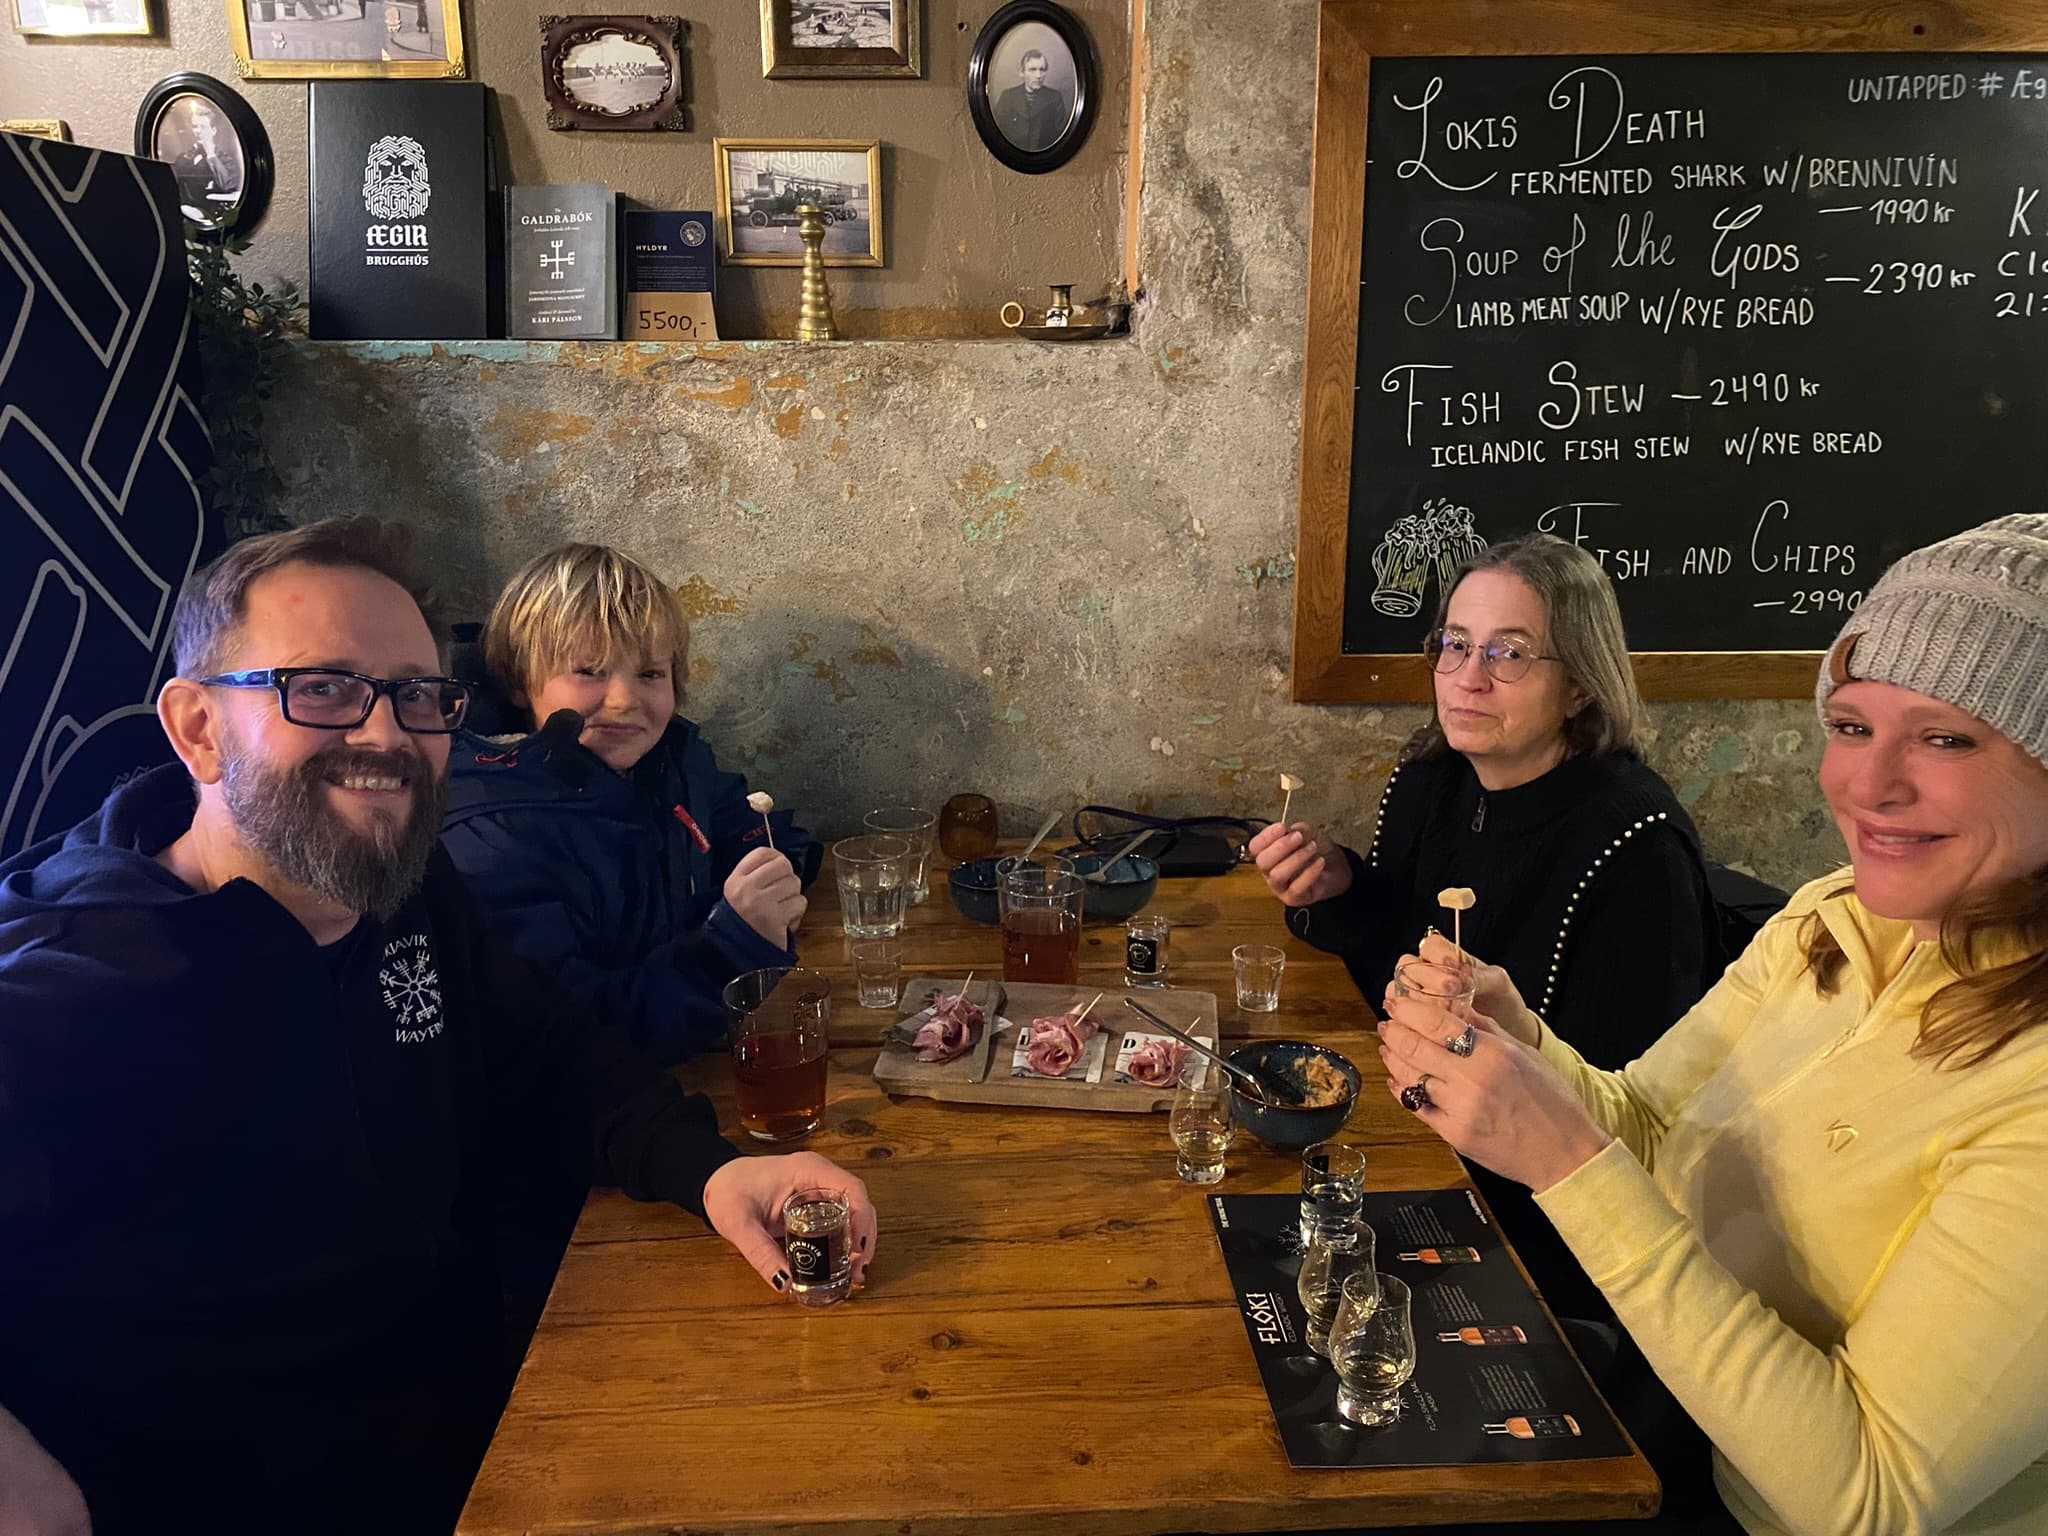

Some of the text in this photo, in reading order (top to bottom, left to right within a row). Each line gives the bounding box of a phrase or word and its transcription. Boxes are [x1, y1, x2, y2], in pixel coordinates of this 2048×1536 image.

[1392, 66, 1706, 192] LOKIS DEATH
[1510, 167, 1653, 197] FERMENTED
[1670, 163, 1747, 190] SHARK
[366, 223, 429, 247] ÆGIR
[520, 210, 593, 226] GALDRABÓK
[365, 253, 430, 266] BRUGGHÚS
[1404, 203, 1800, 329] SOUP of the GODS
[639, 309, 707, 338] 5500,-
[1455, 299, 1516, 329] LAMB
[1521, 298, 1571, 323] MEAT
[1578, 291, 1631, 322] SOUP
[1735, 296, 1815, 329] BREAD
[1380, 364, 1502, 446] FISH
[1538, 360, 1645, 430] STEW
[1430, 439, 1547, 468] ICELANDIC
[1564, 438, 1619, 462] FISH
[1634, 435, 1690, 460] STEW
[1812, 431, 1883, 455] BREAD
[1681, 546, 1732, 576] AND
[1751, 499, 1856, 576] CHIPS
[1245, 1292, 1281, 1345] FLÓKI
